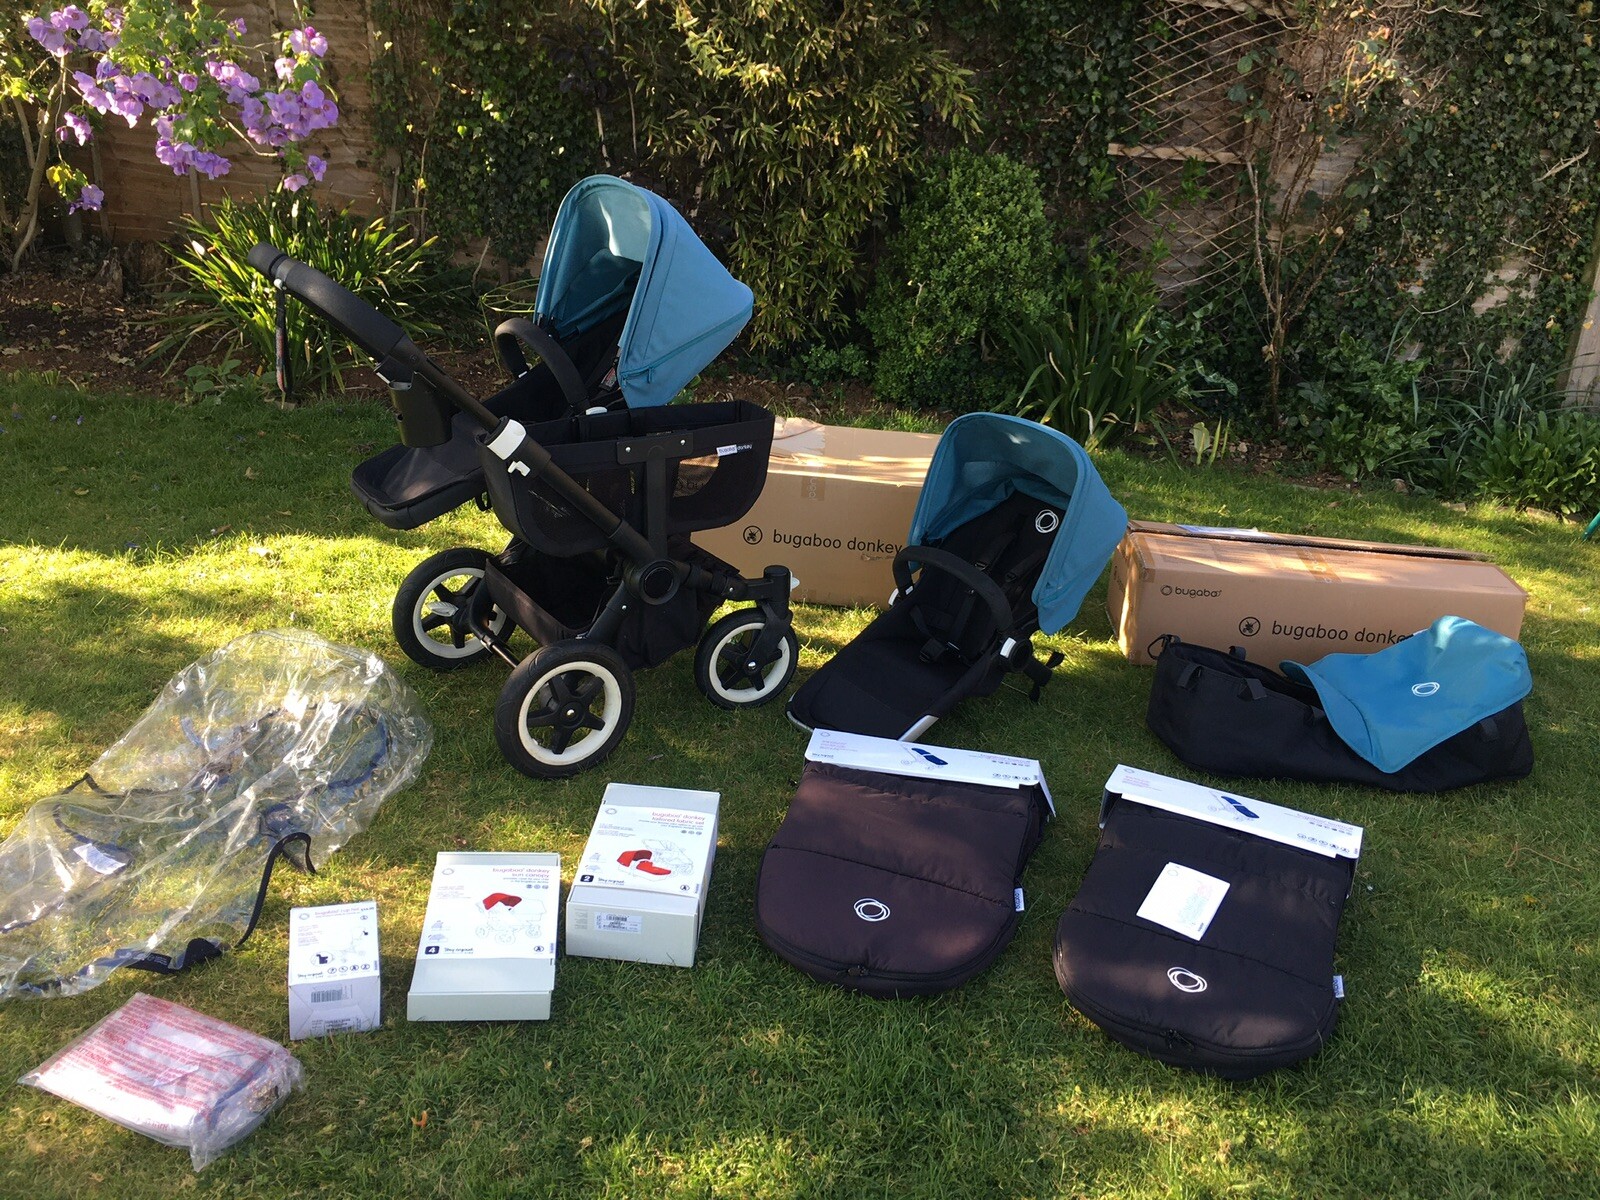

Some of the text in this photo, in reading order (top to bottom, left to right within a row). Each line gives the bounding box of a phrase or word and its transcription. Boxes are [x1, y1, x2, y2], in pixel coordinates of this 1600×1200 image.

[773, 529, 903, 555] bugaboo donkey
[1175, 586, 1223, 599] bugaboo
[1272, 620, 1407, 646] bugaboo donke
[428, 946, 437, 955] 4
